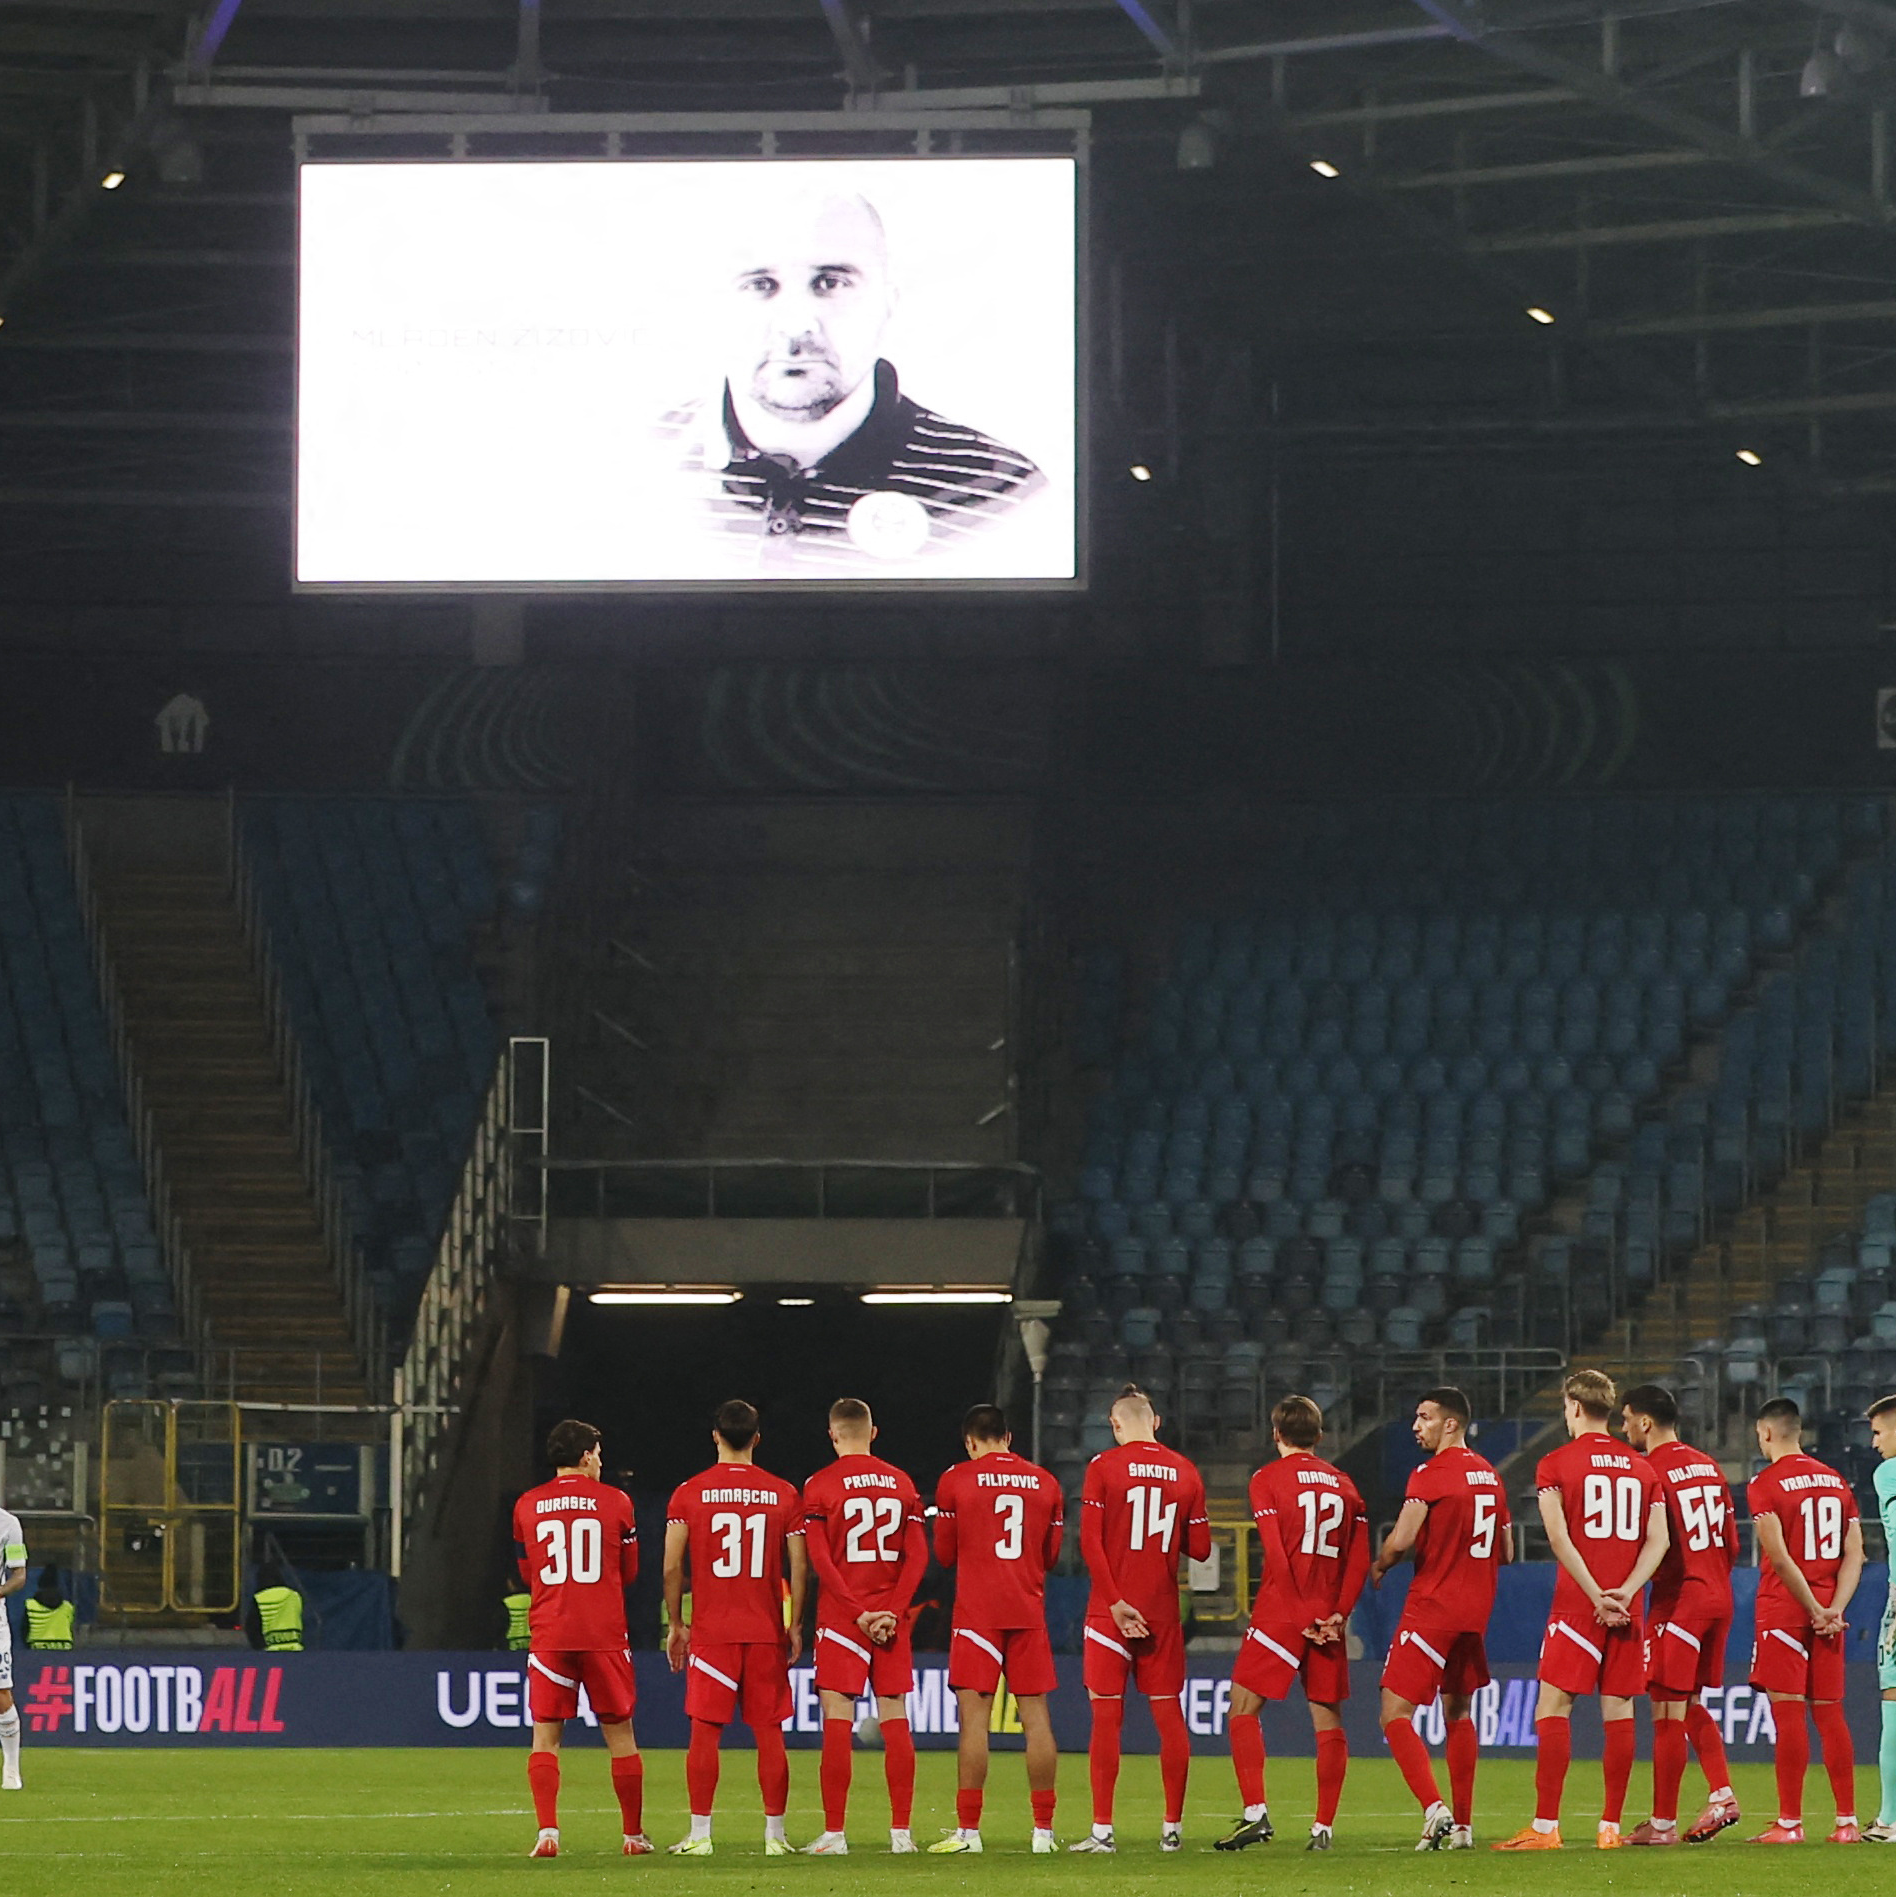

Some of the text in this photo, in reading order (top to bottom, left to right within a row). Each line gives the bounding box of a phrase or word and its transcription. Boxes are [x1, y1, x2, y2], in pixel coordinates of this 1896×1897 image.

[843, 1497, 902, 1563] 22
[994, 1494, 1024, 1560] 3
[1126, 1485, 1178, 1553] 14
[1297, 1490, 1345, 1559] 12
[1469, 1494, 1497, 1559] 5
[1583, 1474, 1642, 1541] 90
[1676, 1485, 1726, 1552] 55
[1801, 1496, 1843, 1561] 19
[536, 1518, 602, 1585] 30
[711, 1512, 767, 1578] 31
[23, 1665, 286, 1733] #FOOTBALL
